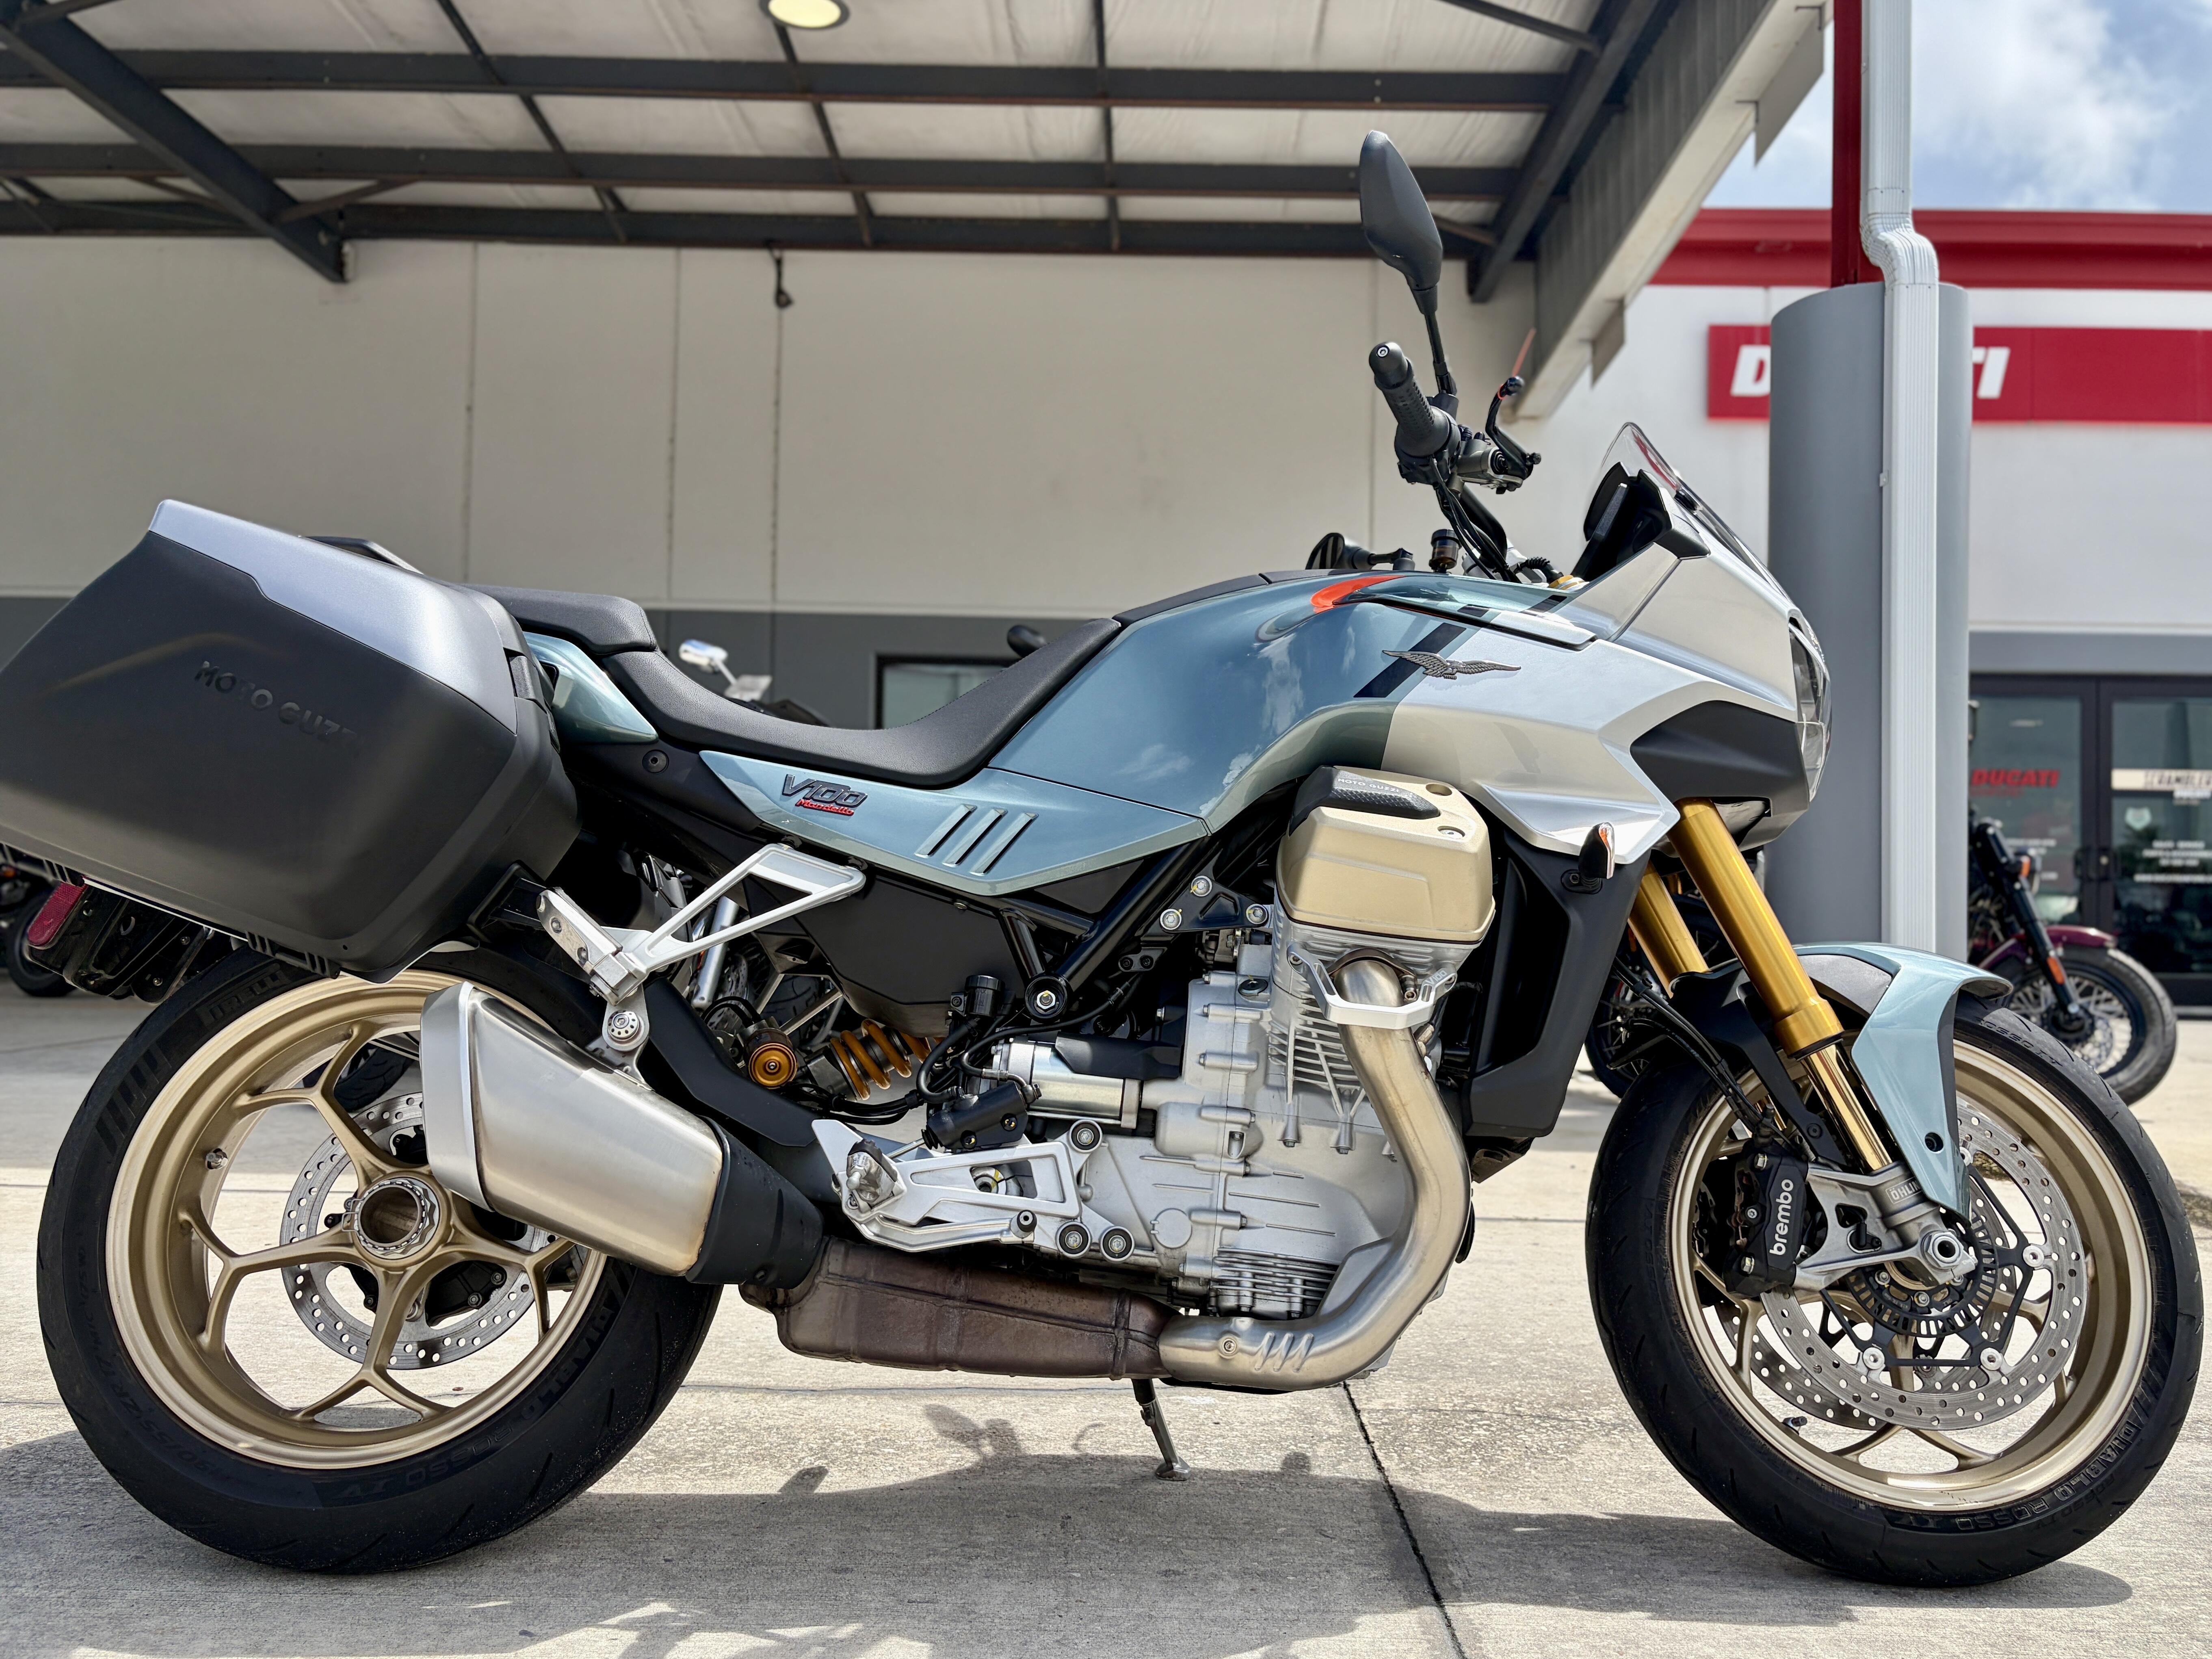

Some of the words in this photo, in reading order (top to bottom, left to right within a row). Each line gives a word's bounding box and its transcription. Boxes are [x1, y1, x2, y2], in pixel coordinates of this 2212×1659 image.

[194, 661, 273, 711] MOTO
[782, 774, 868, 808] V100
[1369, 784, 1400, 793] GUZZI
[1972, 769, 2060, 788] DUCATI
[795, 799, 855, 816] Mandello
[1425, 970, 1447, 984] V100
[195, 963, 290, 1027] PIRELLI
[1769, 1179, 1794, 1255] brembo
[406, 1425, 513, 1486] ROSSO
[2054, 1420, 2142, 1501] DIABLO
[1955, 1497, 2050, 1530] ROSSO
